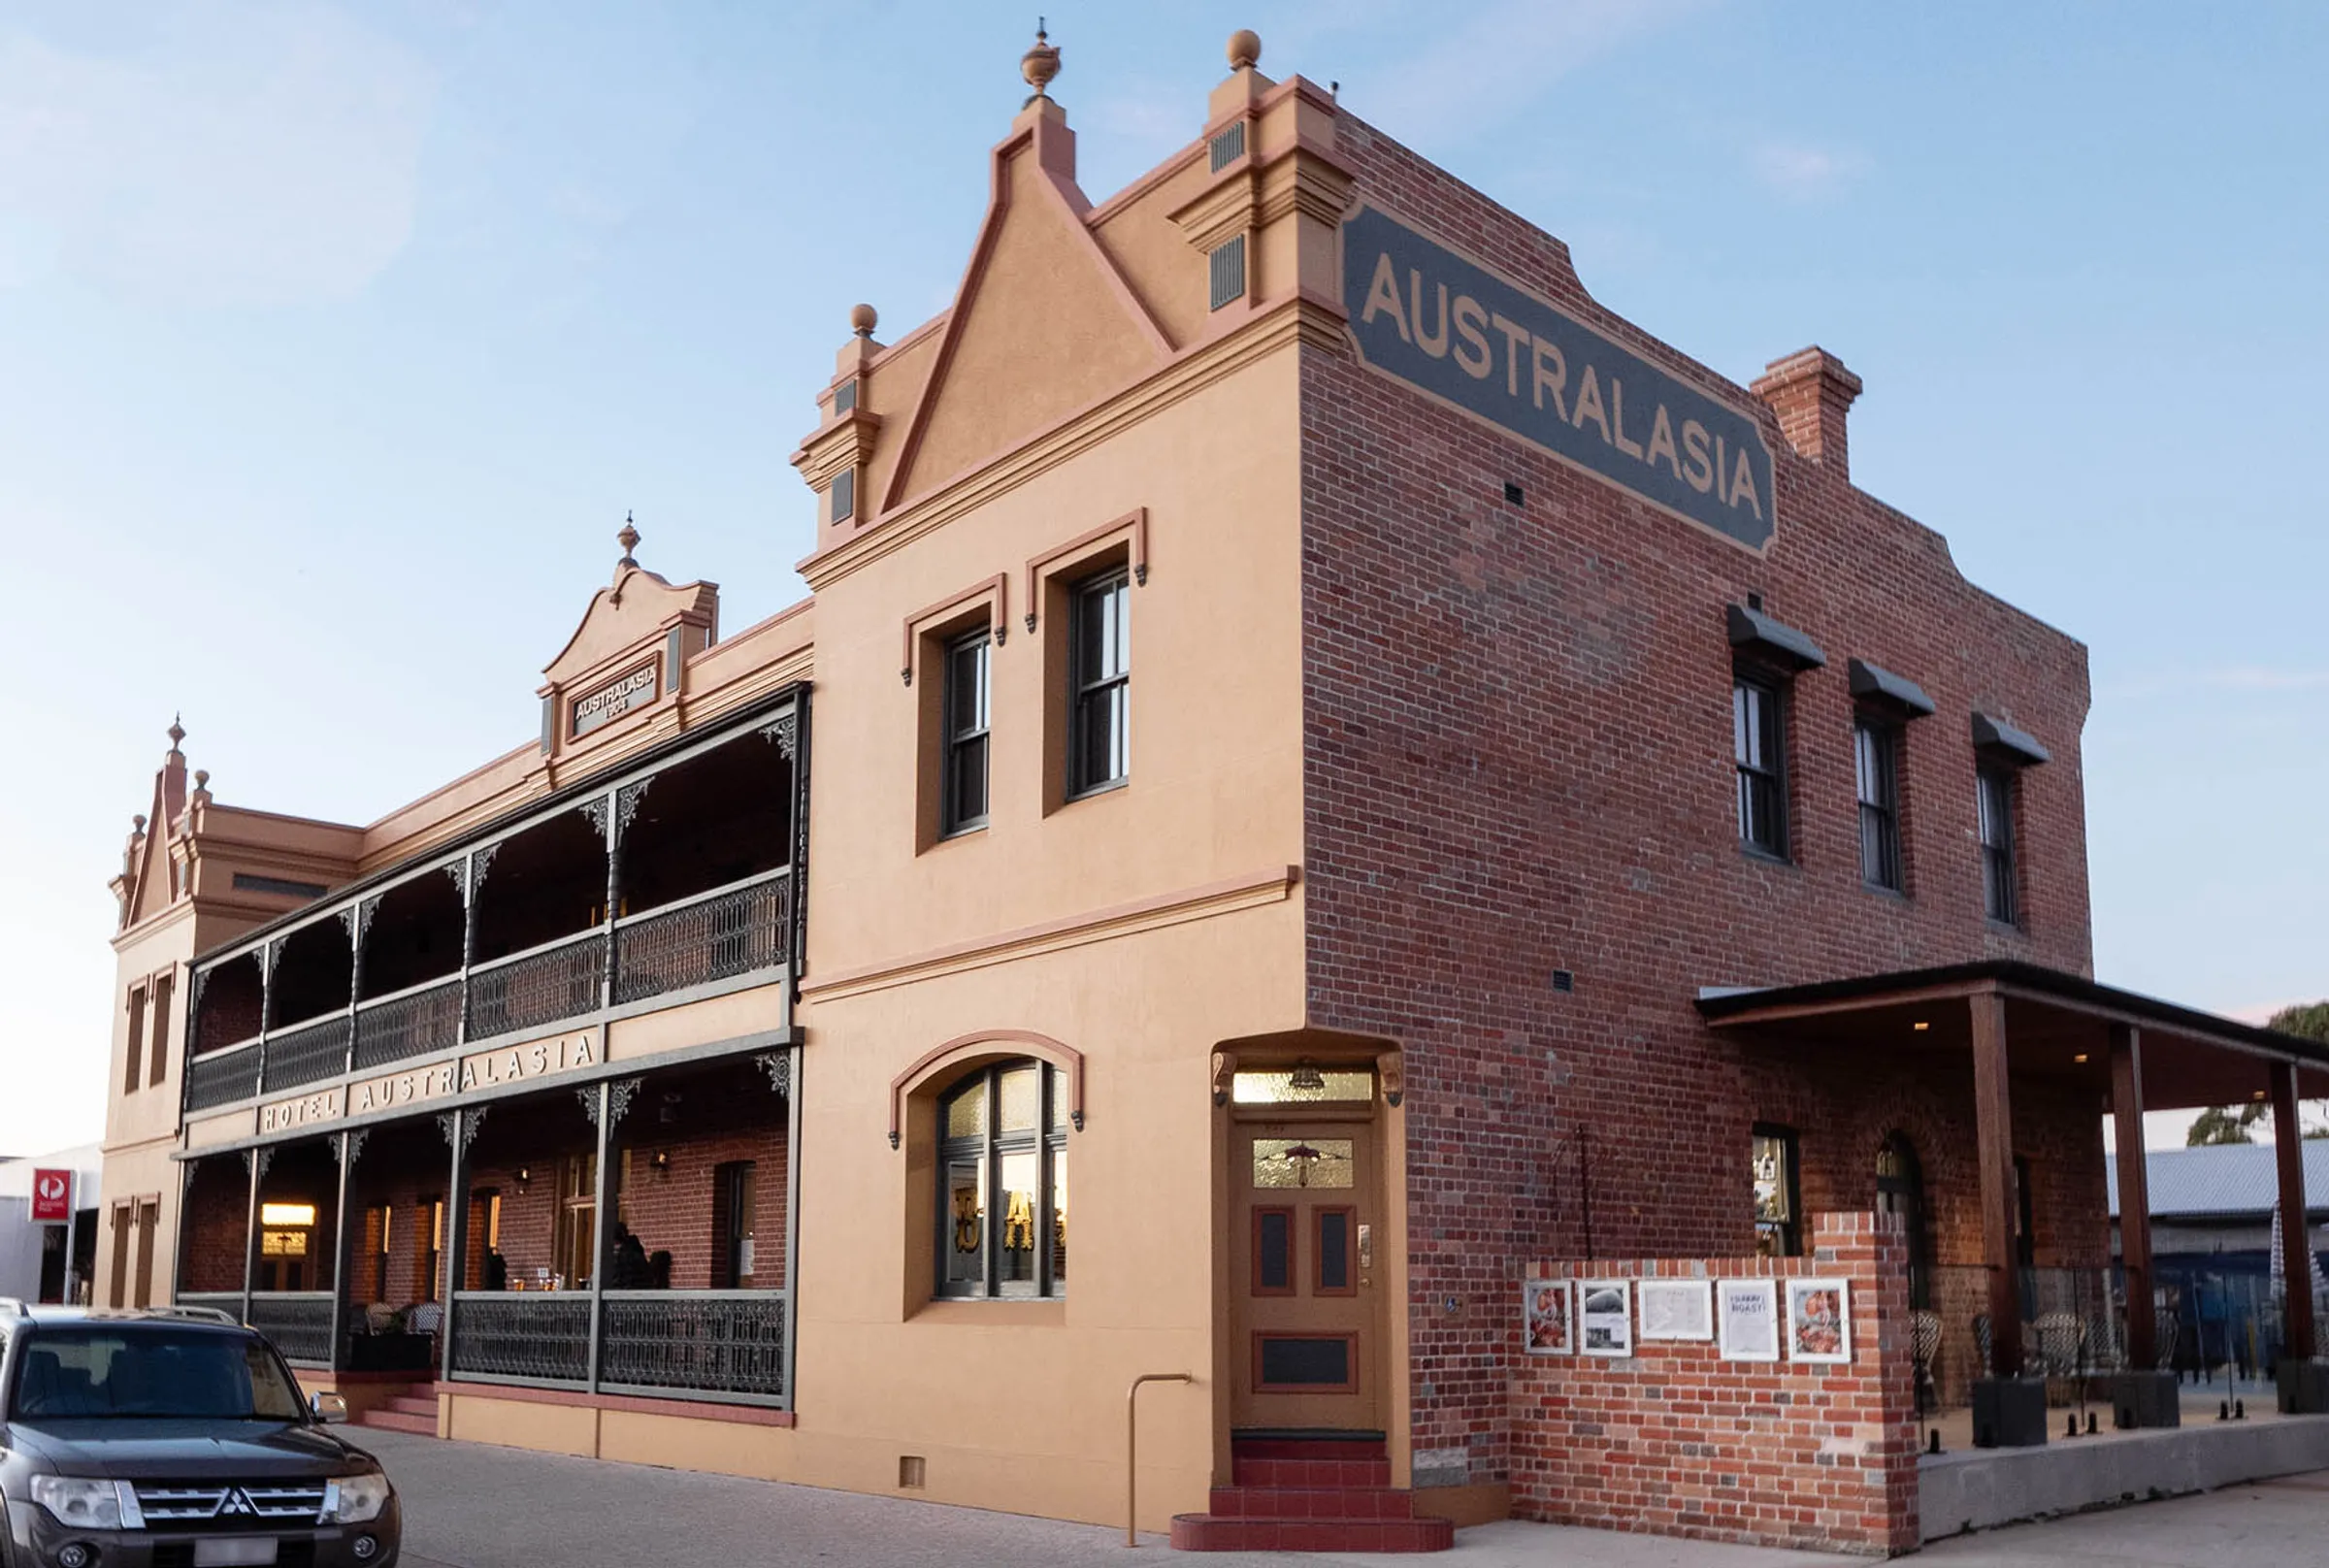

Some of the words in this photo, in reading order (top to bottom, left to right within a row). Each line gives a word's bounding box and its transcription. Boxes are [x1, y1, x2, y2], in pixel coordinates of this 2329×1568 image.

[1361, 252, 1763, 521] AUSTRALASIA
[575, 665, 656, 721] AUSTRALASIA
[264, 1093, 337, 1132] HOTEL
[361, 1034, 594, 1110] AUSTRALASIA
